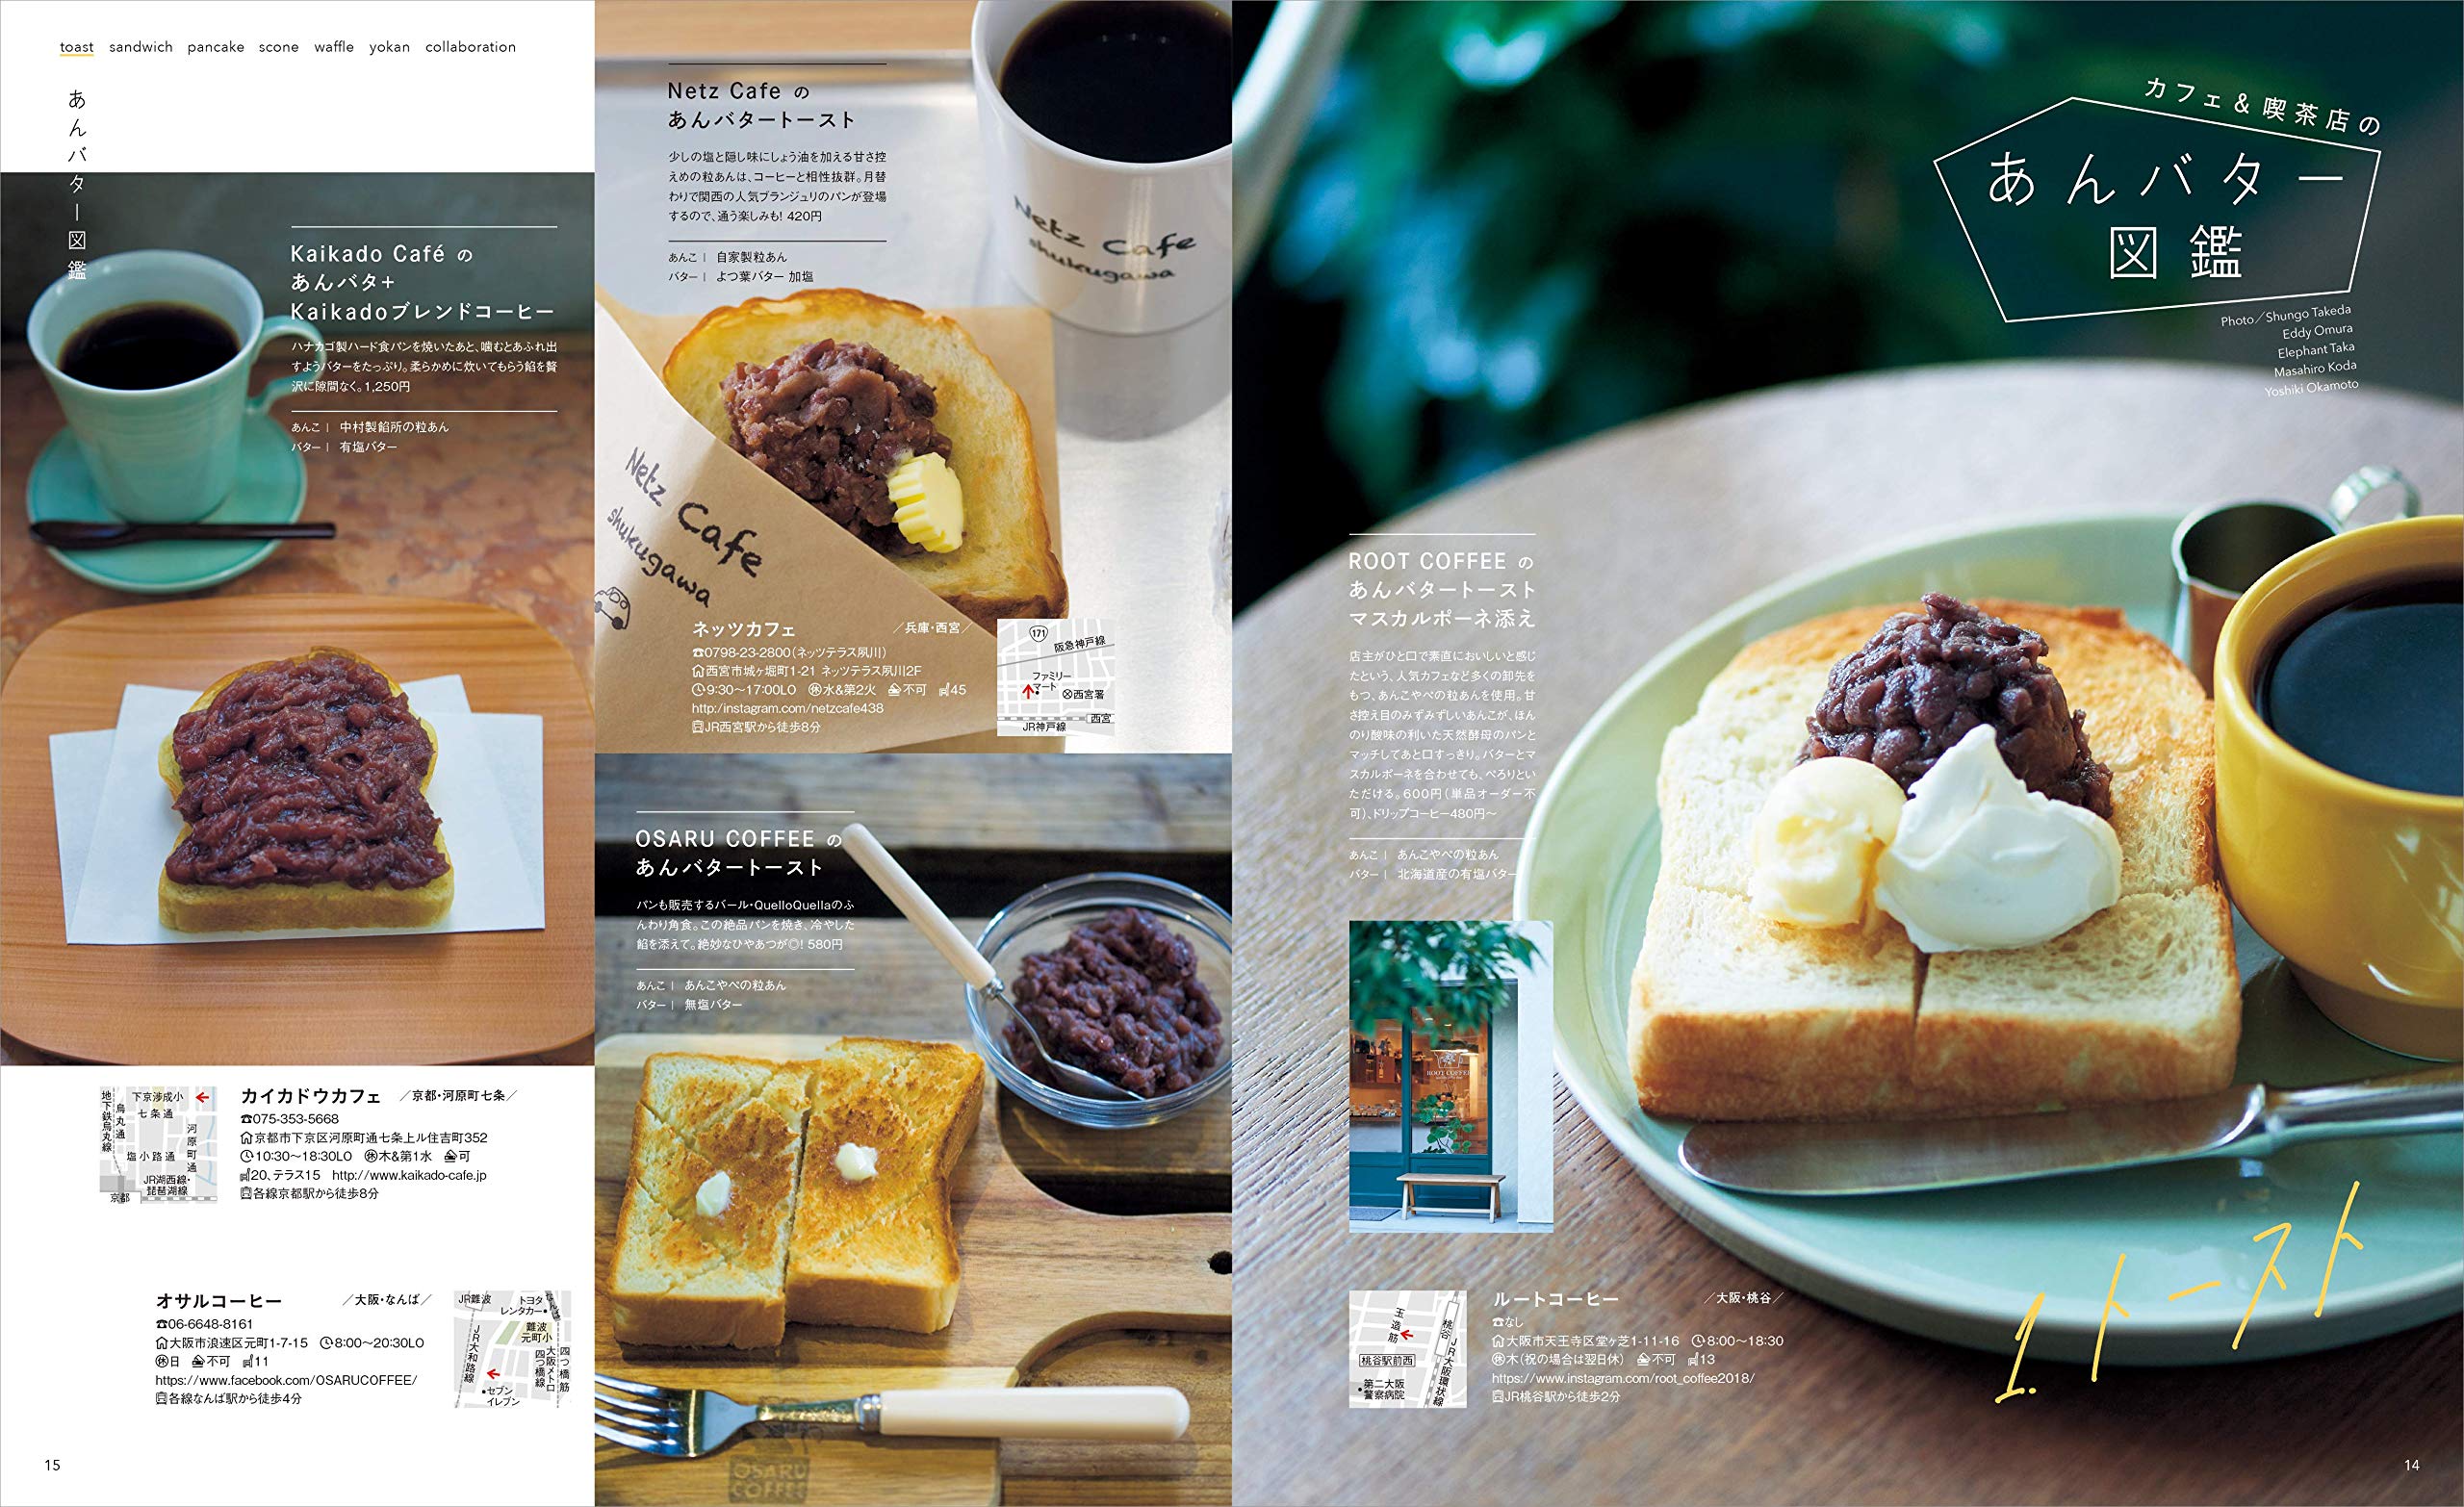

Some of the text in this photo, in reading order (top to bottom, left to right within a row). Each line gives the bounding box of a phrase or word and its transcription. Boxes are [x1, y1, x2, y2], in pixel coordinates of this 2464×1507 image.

[60, 40, 516, 56] toast sandwich pancake scone waffle yokan collaboration
[67, 89, 88, 282] あんバター図鑑
[1014, 194, 1197, 259] Netz Cafe
[626, 447, 762, 577] Netz Cafe
[607, 506, 711, 608] shukugawa
[1032, 629, 1046, 638] 171
[1054, 635, 1106, 653] 阪急神戸線
[1033, 672, 1071, 680] ファミリー
[1033, 682, 1057, 691] マート
[1073, 689, 1105, 700] 西宮署
[1091, 713, 1112, 724] 西宮
[1022, 722, 1066, 732] JR神戸線
[242, 1088, 381, 1105] カイカドウカフェ
[138, 1109, 174, 1119] 七条通
[252, 1114, 340, 1125] 075-353-5668
[187, 1123, 197, 1173] 河原町通
[126, 1151, 176, 1162] 塩小路通
[459, 1151, 471, 1162] 可
[332, 1170, 487, 1184] http://www.kaikado-cafe.jp
[146, 1187, 189, 1197] 琵琶湖線
[253, 1188, 379, 1200] 各線京都駅から徒歩8分
[110, 1193, 131, 1203] 京都
[157, 1293, 282, 1310] オサルコーヒー
[458, 1294, 492, 1305] JR難波
[520, 1296, 543, 1305] トヨタ
[500, 1307, 542, 1315] レンタカー
[167, 1319, 253, 1330] 06-6648-8161
[526, 1322, 547, 1332] 難波
[1441, 1318, 1453, 1340] 桃谷
[169, 1337, 309, 1349] 大阪市浪速区元町1-7-15
[521, 1333, 552, 1343] 元町小
[207, 1356, 269, 1367] 不可 11
[1361, 1356, 1413, 1366] 桃谷駅前西
[535, 1349, 546, 1388] 四つ橋線
[546, 1346, 556, 1392] 大阪メトロ
[559, 1346, 571, 1392] 四つ橋筋
[155, 1374, 417, 1387] https://www.facebook.com/OSARUCOFFEE/
[1364, 1379, 1405, 1390] 第二大阪
[487, 1386, 513, 1395] セブン
[1364, 1390, 1405, 1400] 警察病院
[168, 1392, 302, 1405] 各線なんば駅から徒歩4分
[487, 1396, 521, 1407] イレブン
[44, 1459, 61, 1471] 15
